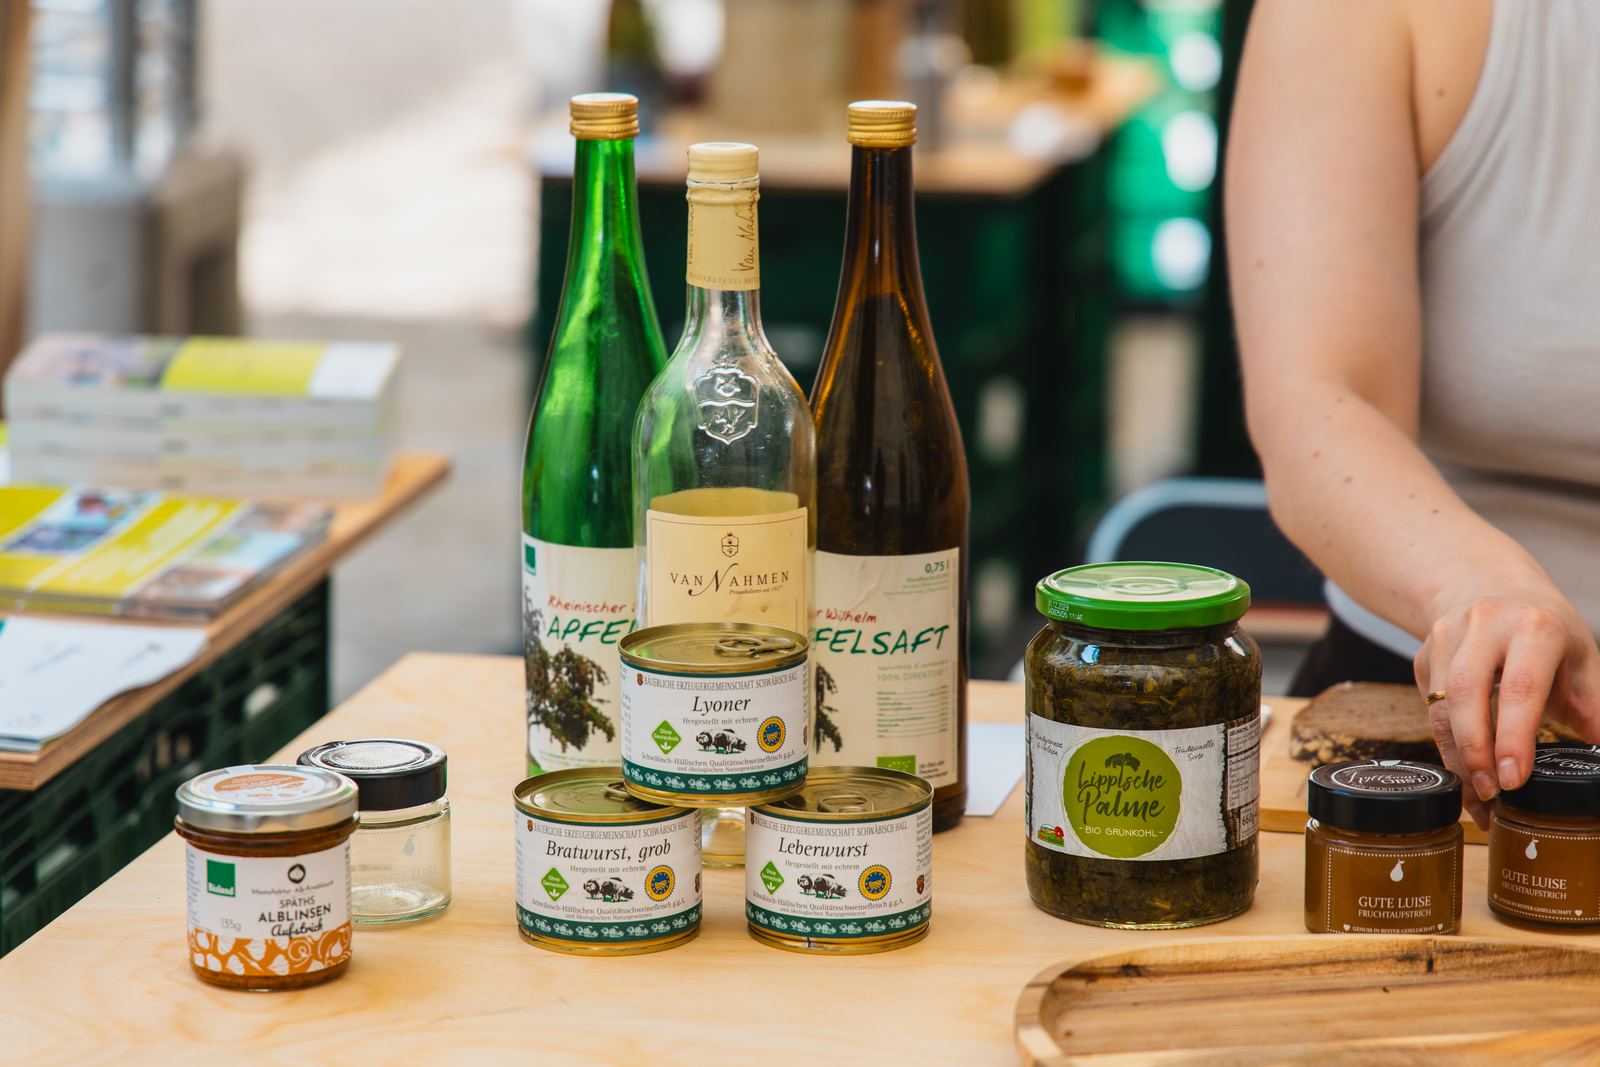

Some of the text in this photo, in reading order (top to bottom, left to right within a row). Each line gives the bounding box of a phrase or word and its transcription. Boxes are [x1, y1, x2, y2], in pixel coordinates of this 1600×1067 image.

[732, 246, 755, 272] Van
[925, 561, 944, 574] 0,75
[669, 562, 789, 597] VAN NAHMEN
[548, 595, 626, 614] Rheinischer
[826, 608, 877, 624] Wilhelm
[644, 676, 676, 690] BÄUERLICHE
[676, 680, 754, 692] ERZEUGERGEMEINSCHAFT
[755, 676, 789, 689] SCHWÄBISCH
[692, 696, 751, 717] Lyoner
[682, 716, 758, 727] Hergestellt mit echtem
[1078, 760, 1168, 795] Lippische
[1077, 784, 1167, 825] Palme
[564, 827, 642, 840] ERZEUGERGEMEINSCHAFT
[642, 824, 678, 837] SCHWÄBISCH
[780, 822, 856, 837] ERZEUGERGEMEINSCHAFT
[856, 823, 895, 837] SCHWÄBISCH
[895, 820, 908, 833] HALL
[1085, 825, 1158, 838] BIO GRÜNKOHL
[546, 839, 671, 862] Bratwurst, grob
[778, 837, 869, 858] Leberwurst
[570, 864, 647, 874] Hergestellt mit echtem
[785, 859, 860, 871] Hergestellt mit echtem
[1502, 868, 1567, 890] GUTE LUISE
[208, 882, 235, 896] Bioland
[251, 888, 291, 896] Manufaktur
[1501, 881, 1567, 900] FRUCHTAUFSTRICH
[280, 895, 316, 909] SPÄTHS
[809, 899, 888, 912] Qualitätsschweinefleisch
[1358, 895, 1433, 909] GUTE LUISE
[258, 903, 332, 923] ALBLINSEN
[1358, 908, 1432, 920] FRUCHTAUFSTRICH
